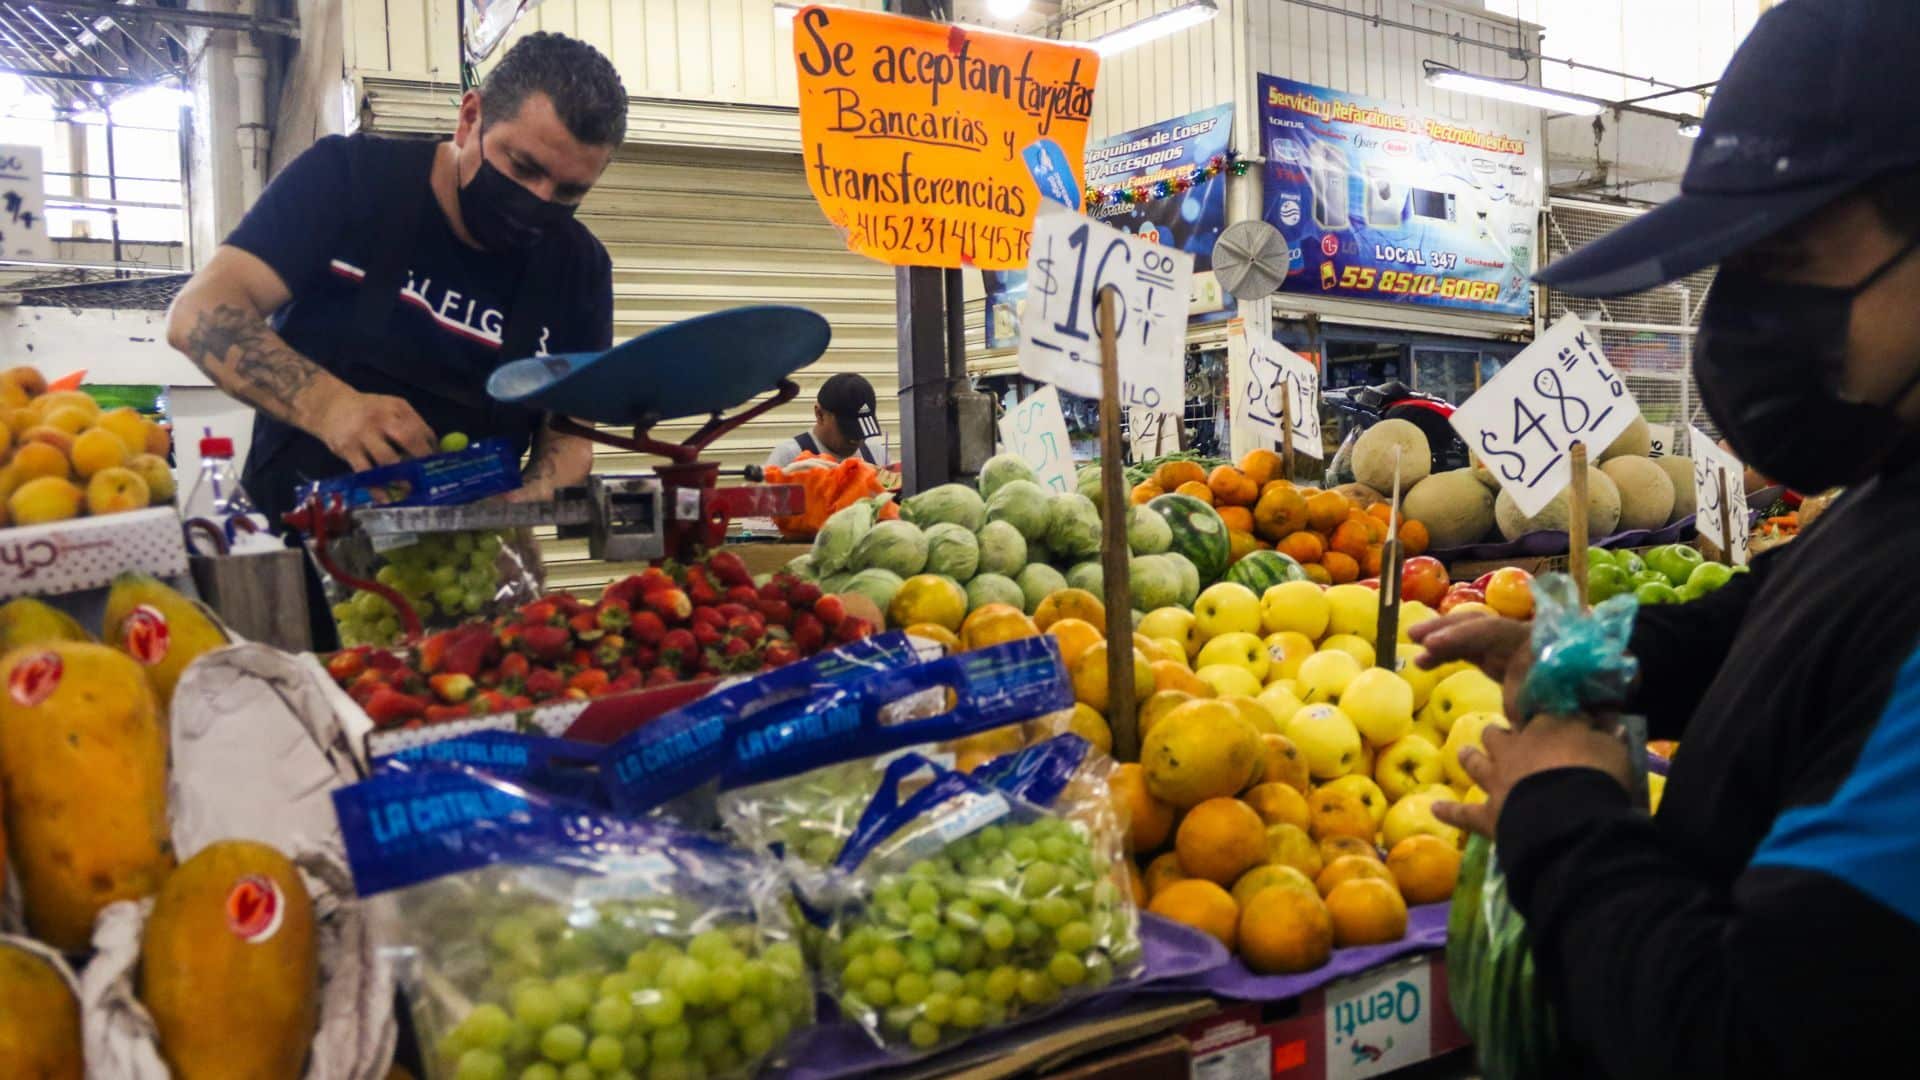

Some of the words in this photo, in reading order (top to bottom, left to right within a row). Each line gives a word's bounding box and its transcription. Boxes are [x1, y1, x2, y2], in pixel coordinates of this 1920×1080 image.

[800, 8, 855, 77] Se
[872, 39, 1012, 106] aceptan
[1013, 50, 1095, 136] tarjetas
[823, 86, 988, 147] Bancarias
[1002, 129, 1016, 163] y
[1269, 85, 1319, 118] Servicio
[1320, 99, 1331, 123] y
[1150, 131, 1170, 145] de
[1172, 117, 1218, 140] Coser
[813, 142, 1026, 218] transferencias
[1375, 244, 1426, 266] LOCAL
[1431, 252, 1457, 269] 347
[1339, 264, 1377, 290] 55
[1377, 269, 1500, 304] 8510-6068
[1574, 331, 1623, 398] KILO
[1122, 380, 1161, 408] ILO
[1480, 367, 1590, 482] $48
[427, 744, 529, 767] CATALINA
[615, 753, 642, 785] LA
[643, 715, 727, 772] CATALINA
[735, 728, 766, 761] LA
[369, 799, 409, 845] LA
[1334, 980, 1421, 1044] Qenti
